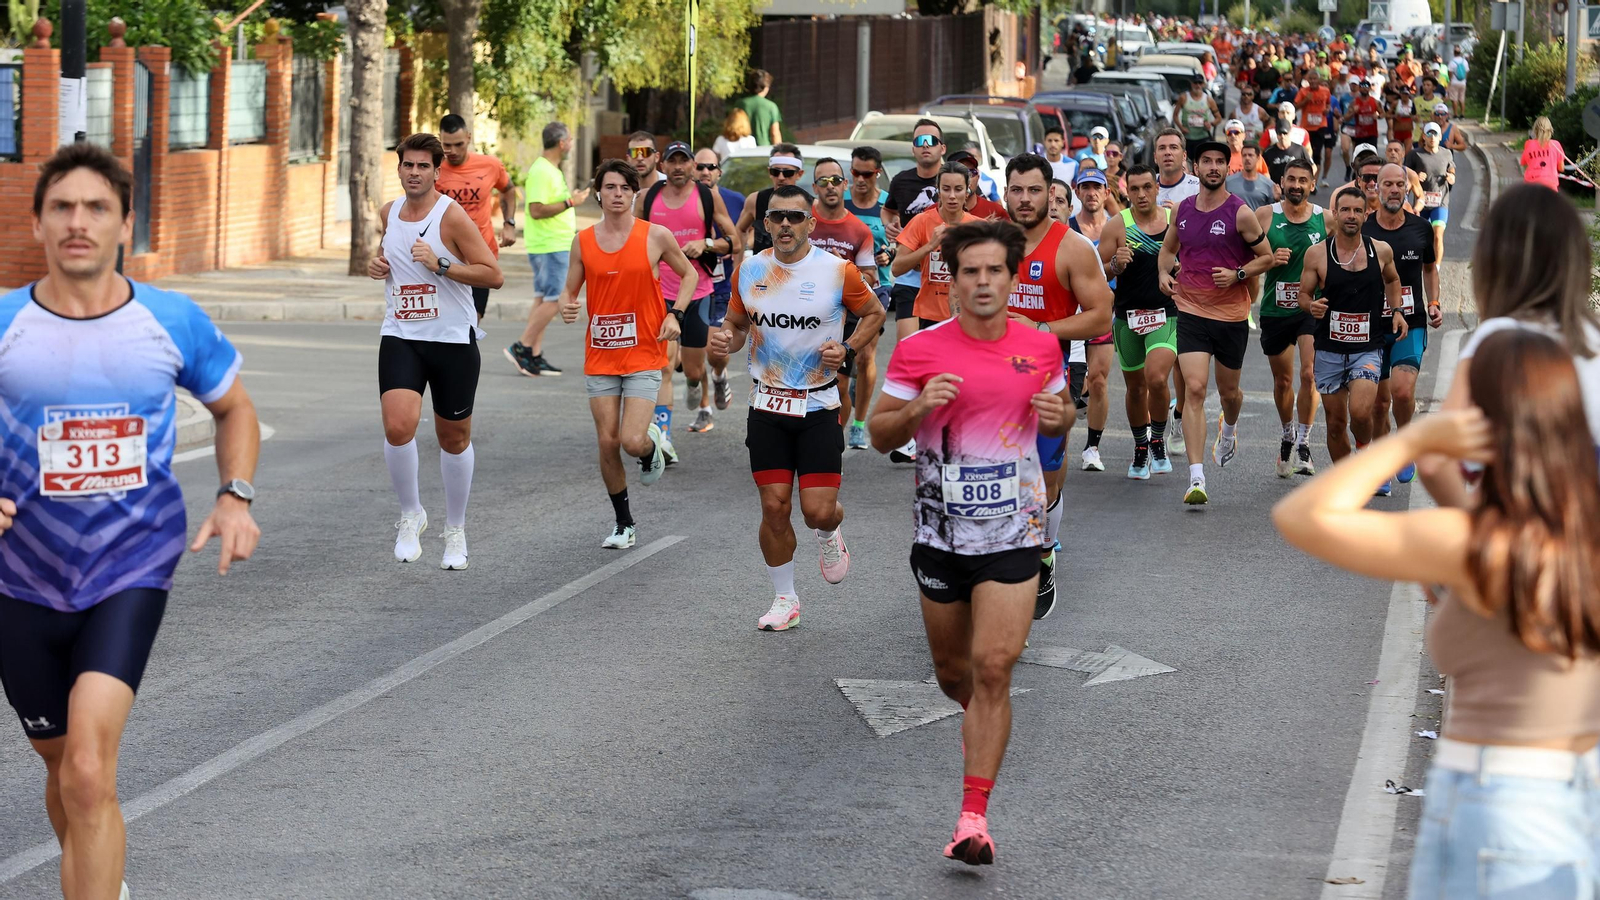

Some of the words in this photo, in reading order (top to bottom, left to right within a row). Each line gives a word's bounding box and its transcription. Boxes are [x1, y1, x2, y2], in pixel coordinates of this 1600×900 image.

[402, 296, 424, 308] 311
[1138, 315, 1156, 325] 488
[600, 326, 624, 337] 207
[1339, 322, 1360, 333] 508
[766, 397, 792, 412] 471
[67, 443, 120, 468] 313
[962, 483, 1001, 501] 808
